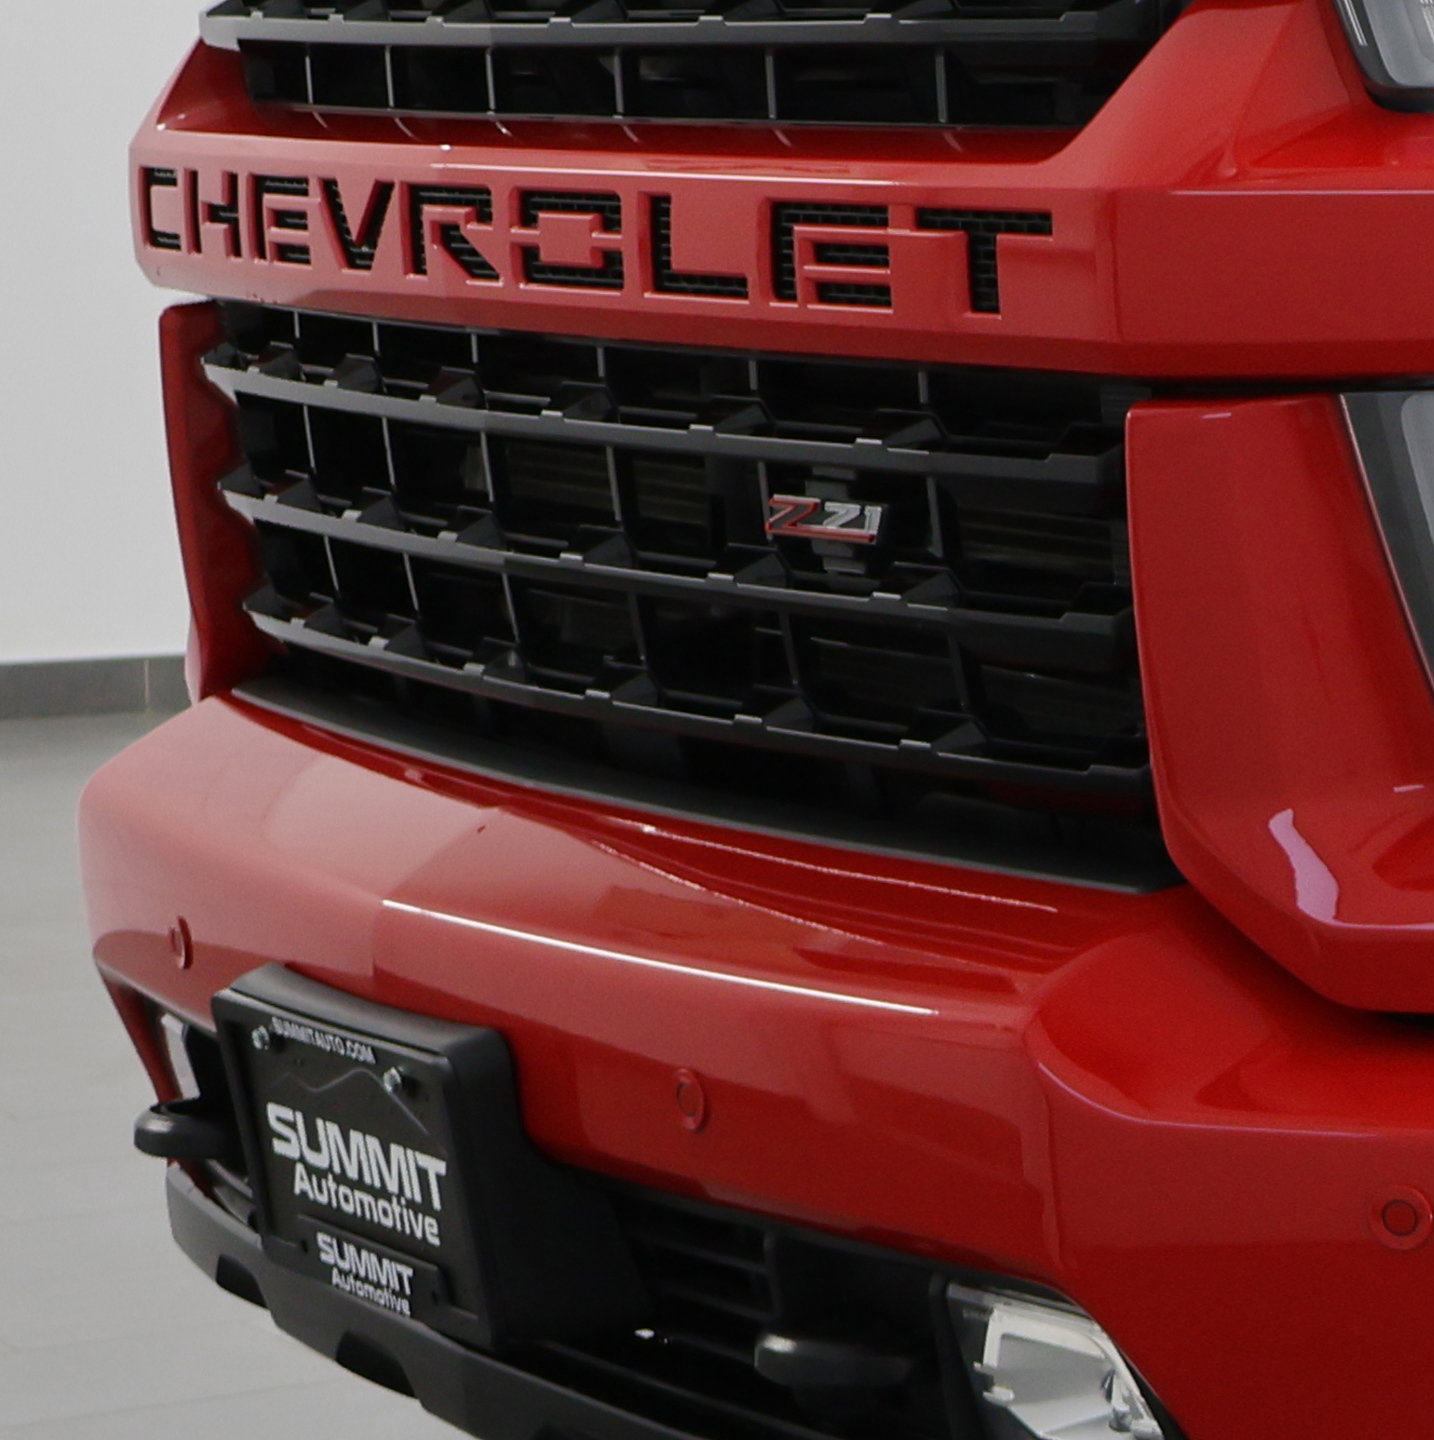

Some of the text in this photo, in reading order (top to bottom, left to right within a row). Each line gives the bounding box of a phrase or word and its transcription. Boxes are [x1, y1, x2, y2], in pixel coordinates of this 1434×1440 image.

[137, 166, 1055, 318] CHEVROLET
[764, 494, 882, 544] Z71
[271, 1016, 376, 1064] SUMMITAUTO.COM
[266, 1101, 447, 1211] SUMMIT
[294, 1162, 441, 1247] Automotive
[316, 1231, 413, 1296] SUMMIT
[331, 1266, 411, 1318] Automotive
